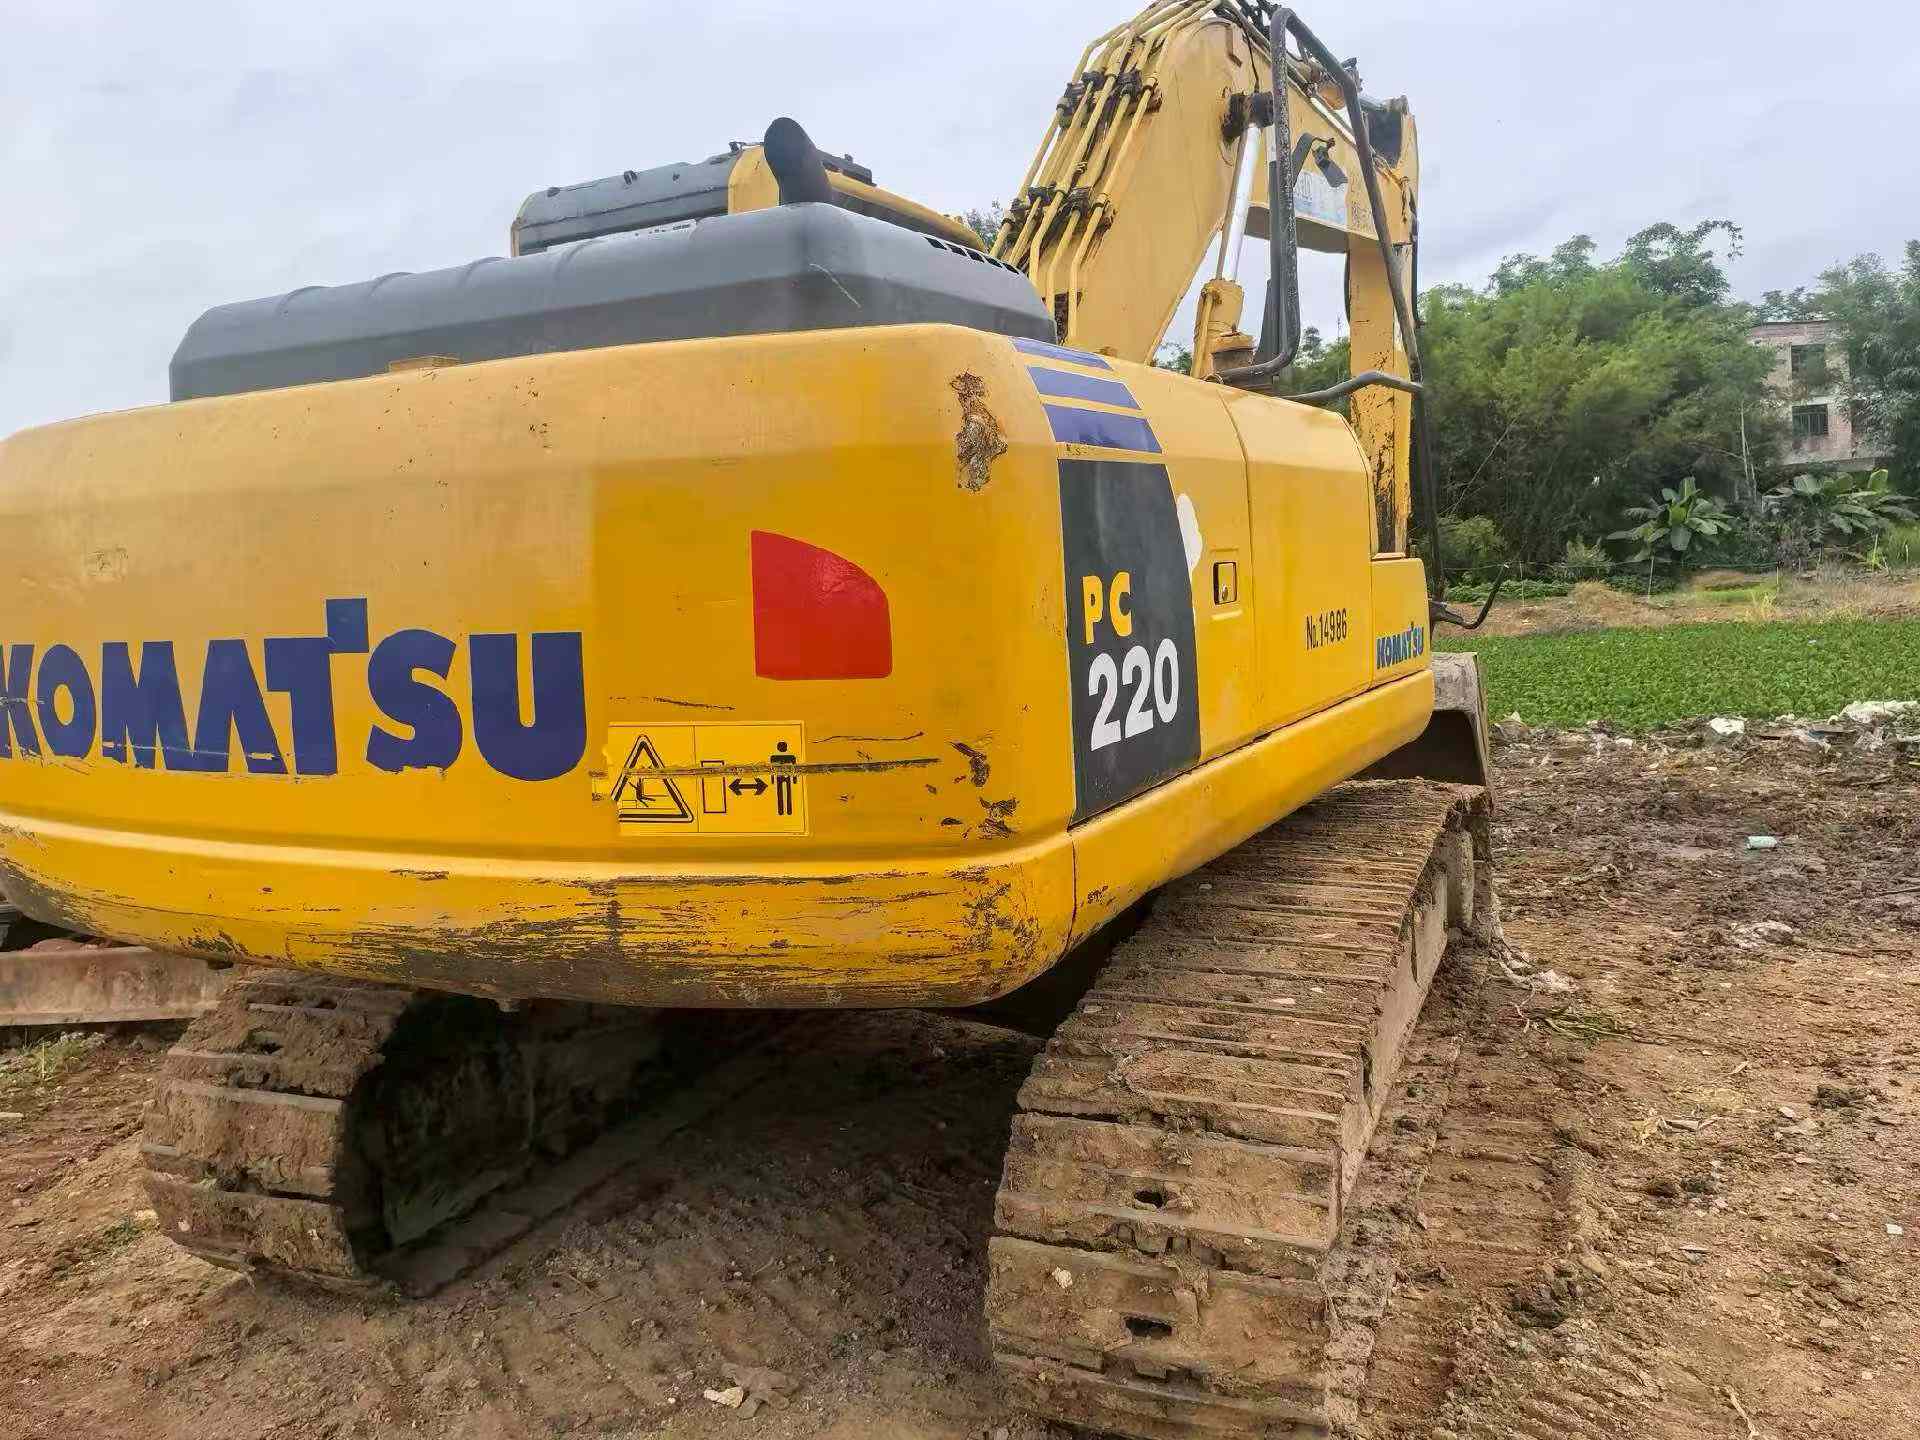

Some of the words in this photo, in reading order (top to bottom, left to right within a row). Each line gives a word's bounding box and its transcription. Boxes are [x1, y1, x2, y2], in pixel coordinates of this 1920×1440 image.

[1082, 571, 1133, 645] PC
[1376, 621, 1425, 669] KOMATSU
[0, 598, 588, 782] KOMATSU
[1088, 638, 1180, 752] 220
